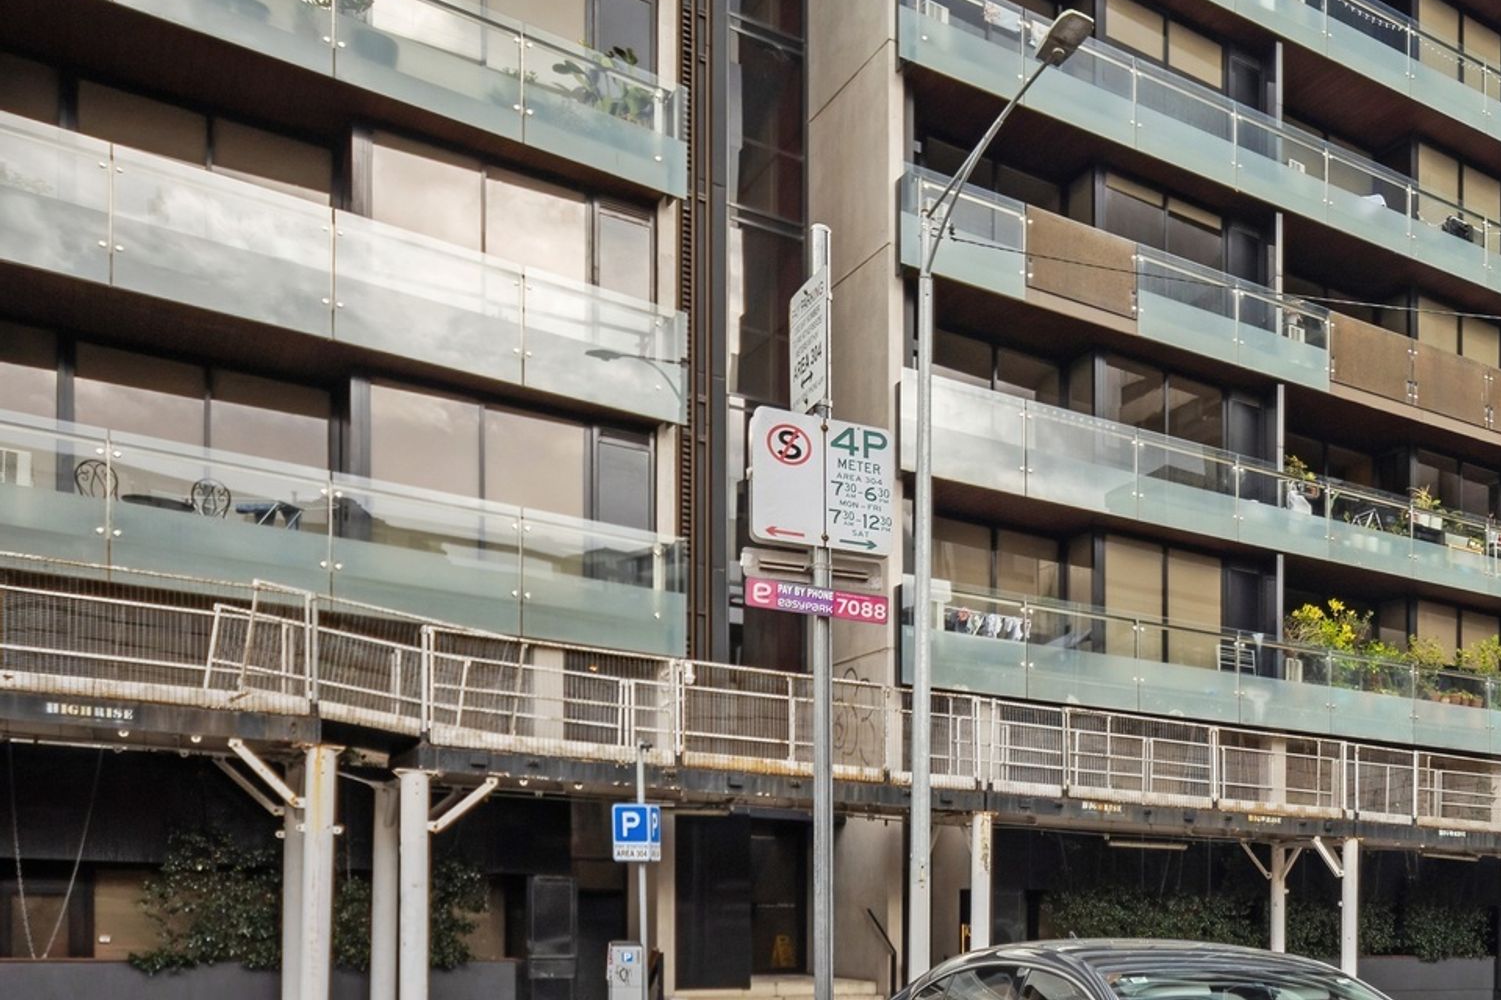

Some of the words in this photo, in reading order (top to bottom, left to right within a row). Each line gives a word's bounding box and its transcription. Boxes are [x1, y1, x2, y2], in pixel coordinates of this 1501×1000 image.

[830, 427, 888, 459] 4P
[838, 458, 881, 475] METER
[837, 472, 862, 483] AREA
[839, 500, 859, 509] MON
[867, 503, 882, 512] FRI
[852, 529, 869, 538] SAT
[777, 584, 792, 596] PAY
[794, 585, 806, 597] BY
[807, 587, 833, 601] PHONE
[836, 598, 886, 620] 7088
